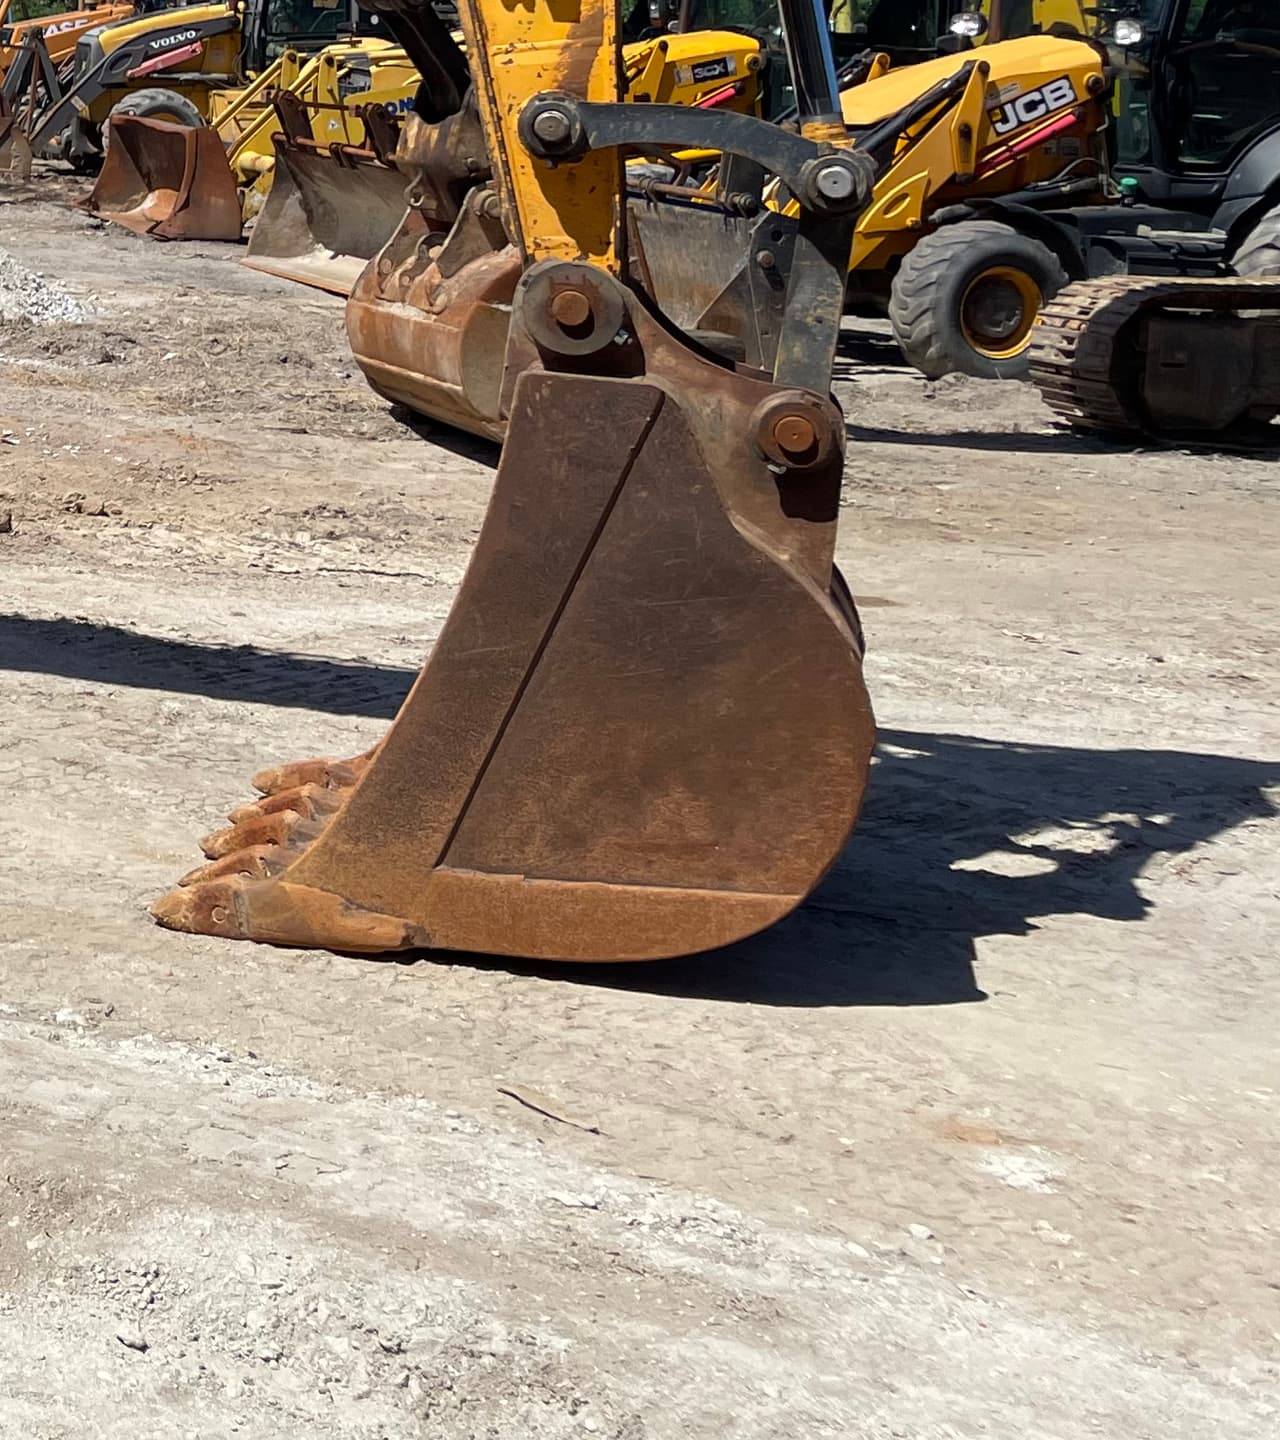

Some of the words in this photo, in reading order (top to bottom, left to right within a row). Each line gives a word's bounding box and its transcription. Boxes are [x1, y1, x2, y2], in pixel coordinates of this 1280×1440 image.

[43, 19, 89, 37] ASE
[149, 30, 197, 49] VOLVO
[693, 62, 726, 80] 3CX
[994, 78, 1076, 133] JCB
